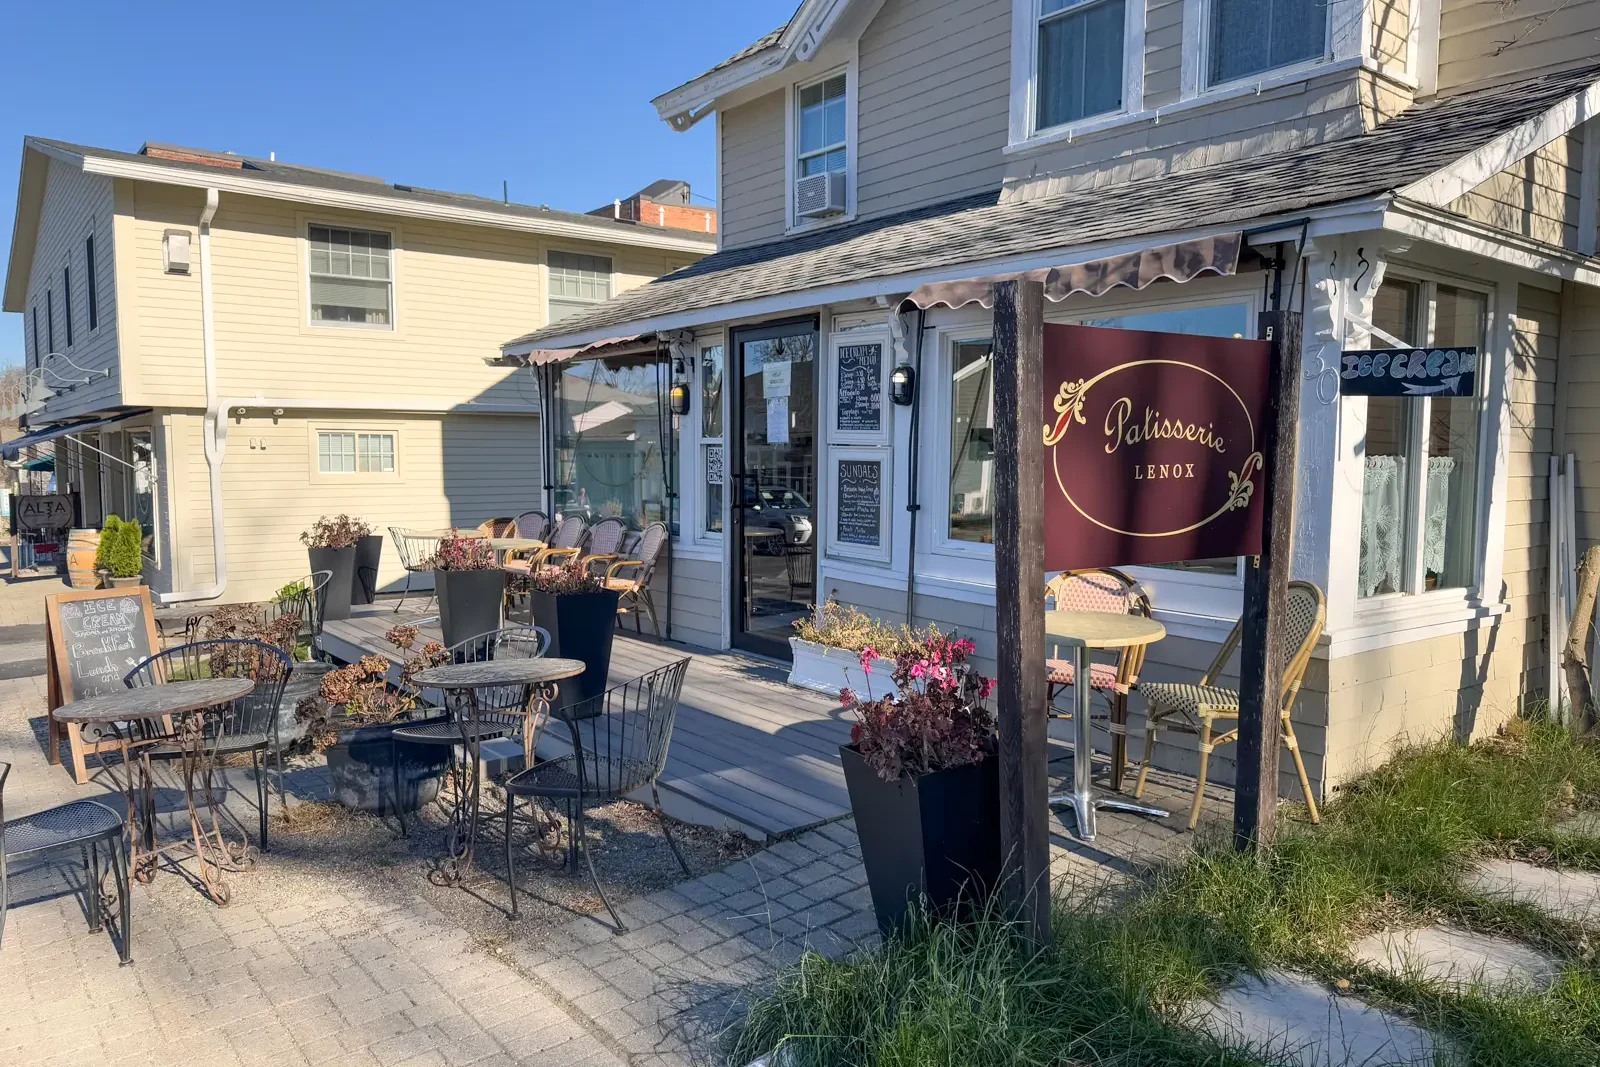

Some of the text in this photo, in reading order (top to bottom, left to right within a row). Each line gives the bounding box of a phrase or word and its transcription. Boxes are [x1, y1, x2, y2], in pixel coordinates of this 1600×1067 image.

[1104, 397, 1226, 454] Patisserie
[840, 464, 878, 478] SUNDAES
[1134, 463, 1195, 480] LENOX
[24, 501, 66, 519] ALTA
[70, 554, 78, 565] A
[84, 599, 116, 614] ICE
[83, 612, 126, 630] CREAM
[76, 656, 119, 678] Lunch
[101, 673, 121, 683] and
